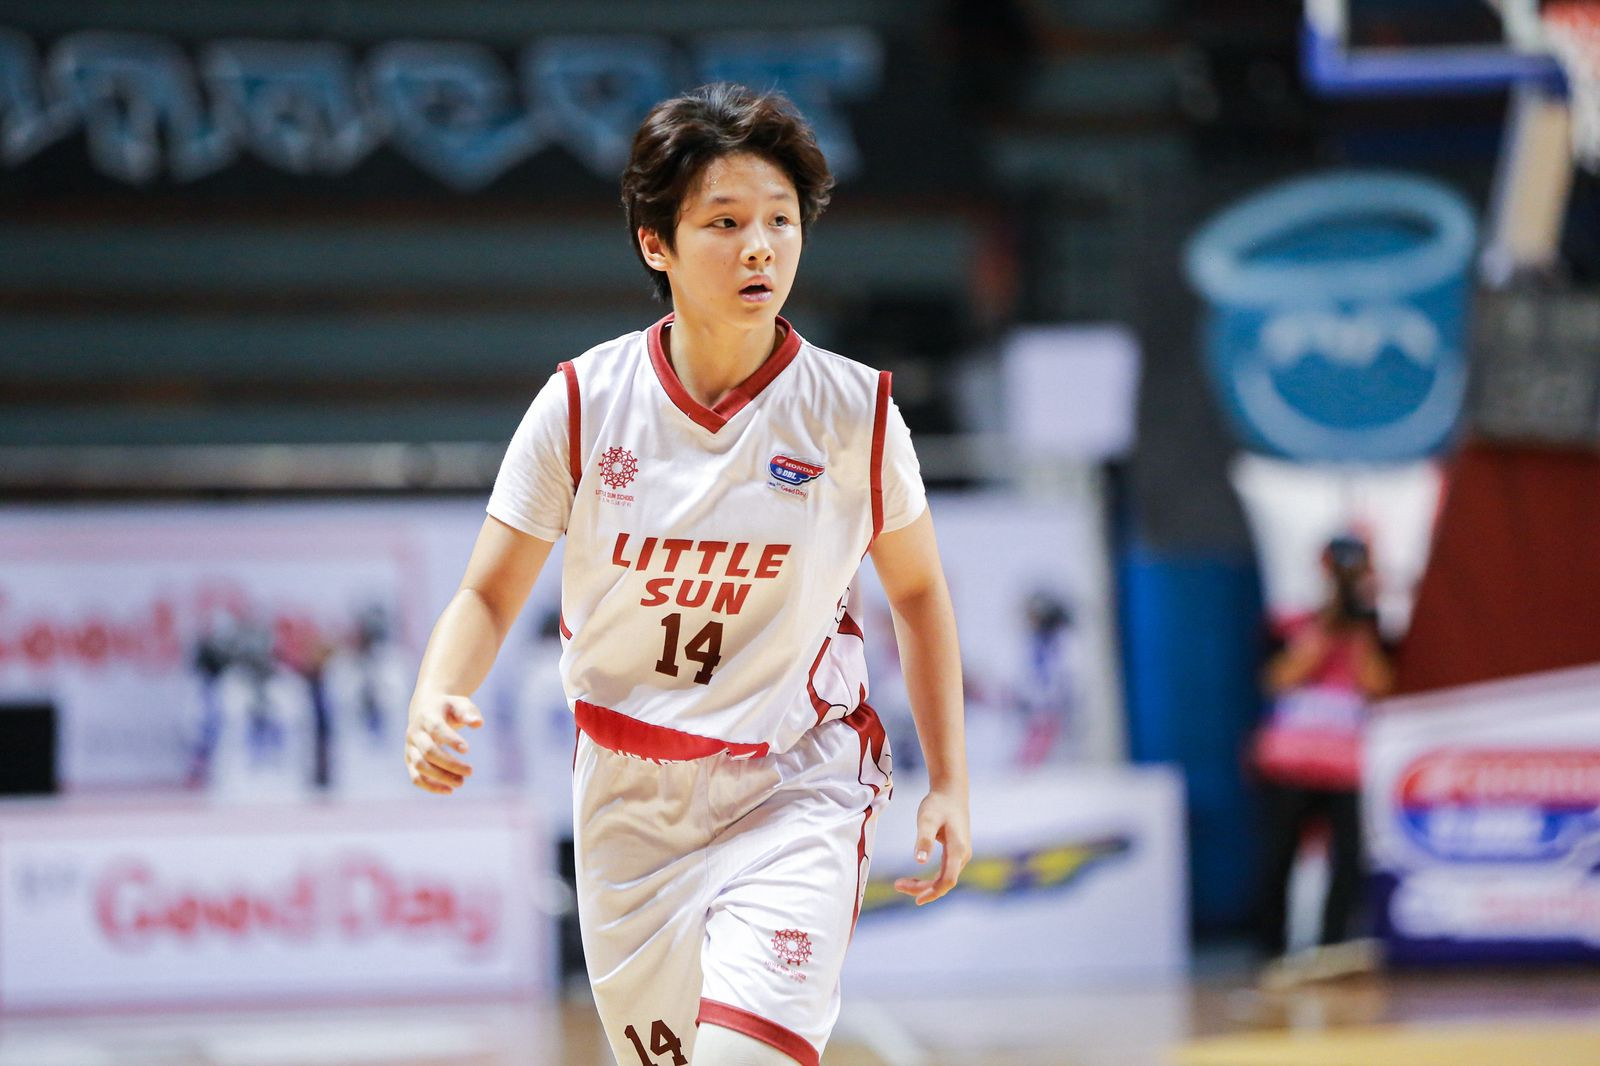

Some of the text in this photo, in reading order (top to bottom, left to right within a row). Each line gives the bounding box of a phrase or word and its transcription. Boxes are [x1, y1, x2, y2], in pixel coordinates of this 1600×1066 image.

[786, 462, 814, 474] HONDA
[612, 533, 792, 578] LITTLE
[640, 578, 752, 615] SUN
[655, 613, 723, 685] 14
[624, 1019, 688, 1066] 14
